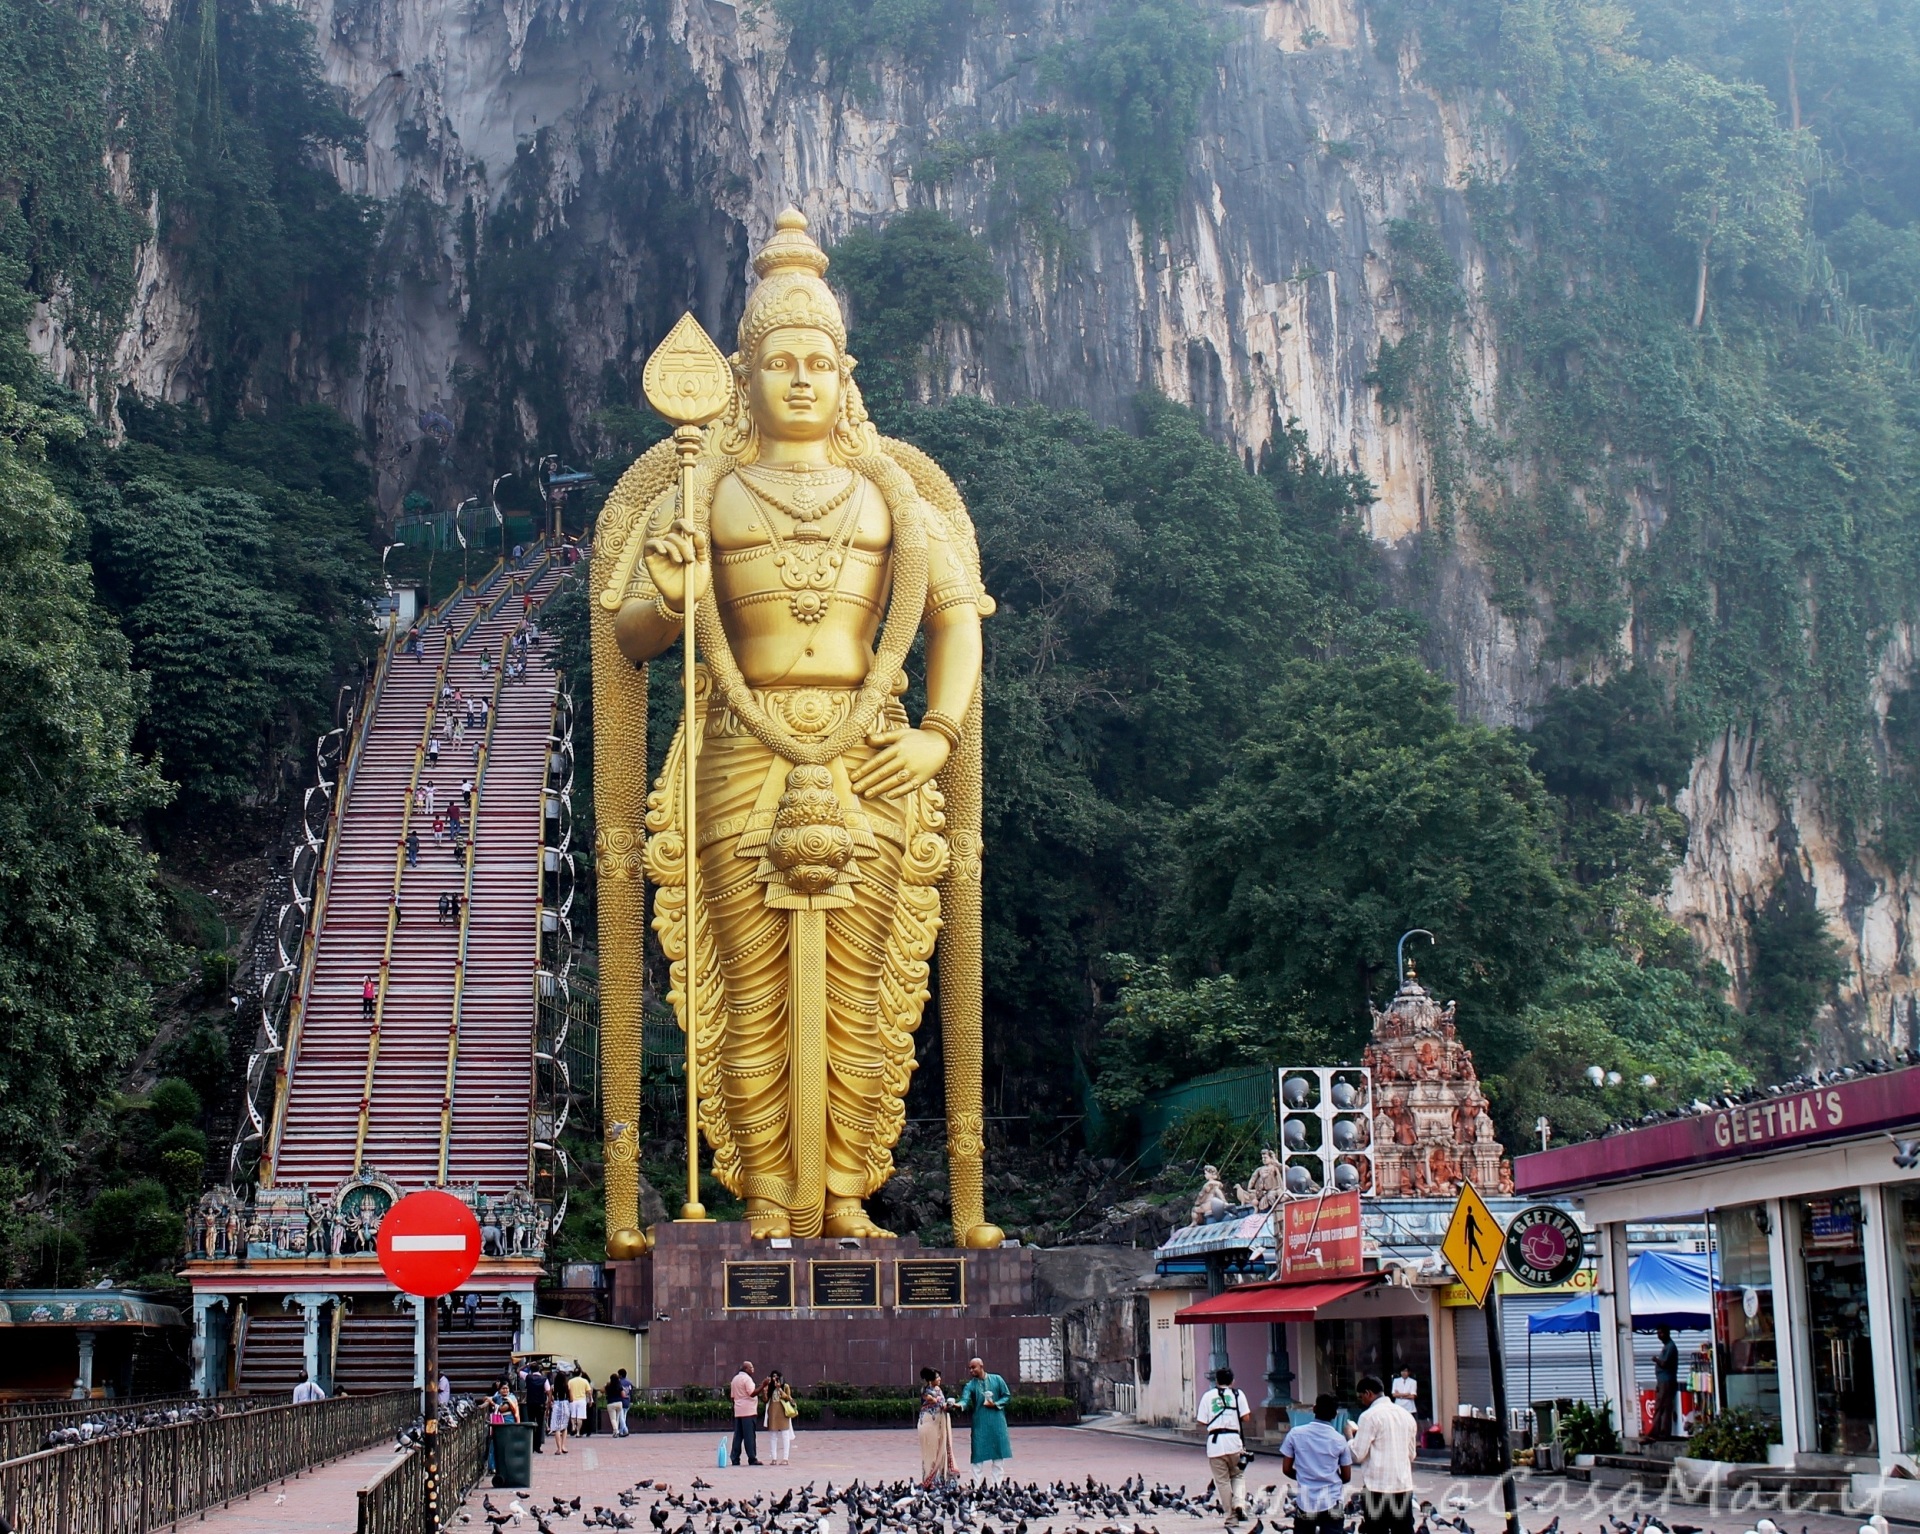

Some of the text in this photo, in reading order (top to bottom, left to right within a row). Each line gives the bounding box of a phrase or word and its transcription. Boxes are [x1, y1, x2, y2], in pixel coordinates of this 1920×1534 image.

[1714, 1091, 1843, 1147] GEETHA'S
[1513, 1210, 1580, 1249] GEETHA'S
[1519, 1264, 1553, 1282] CAFE
